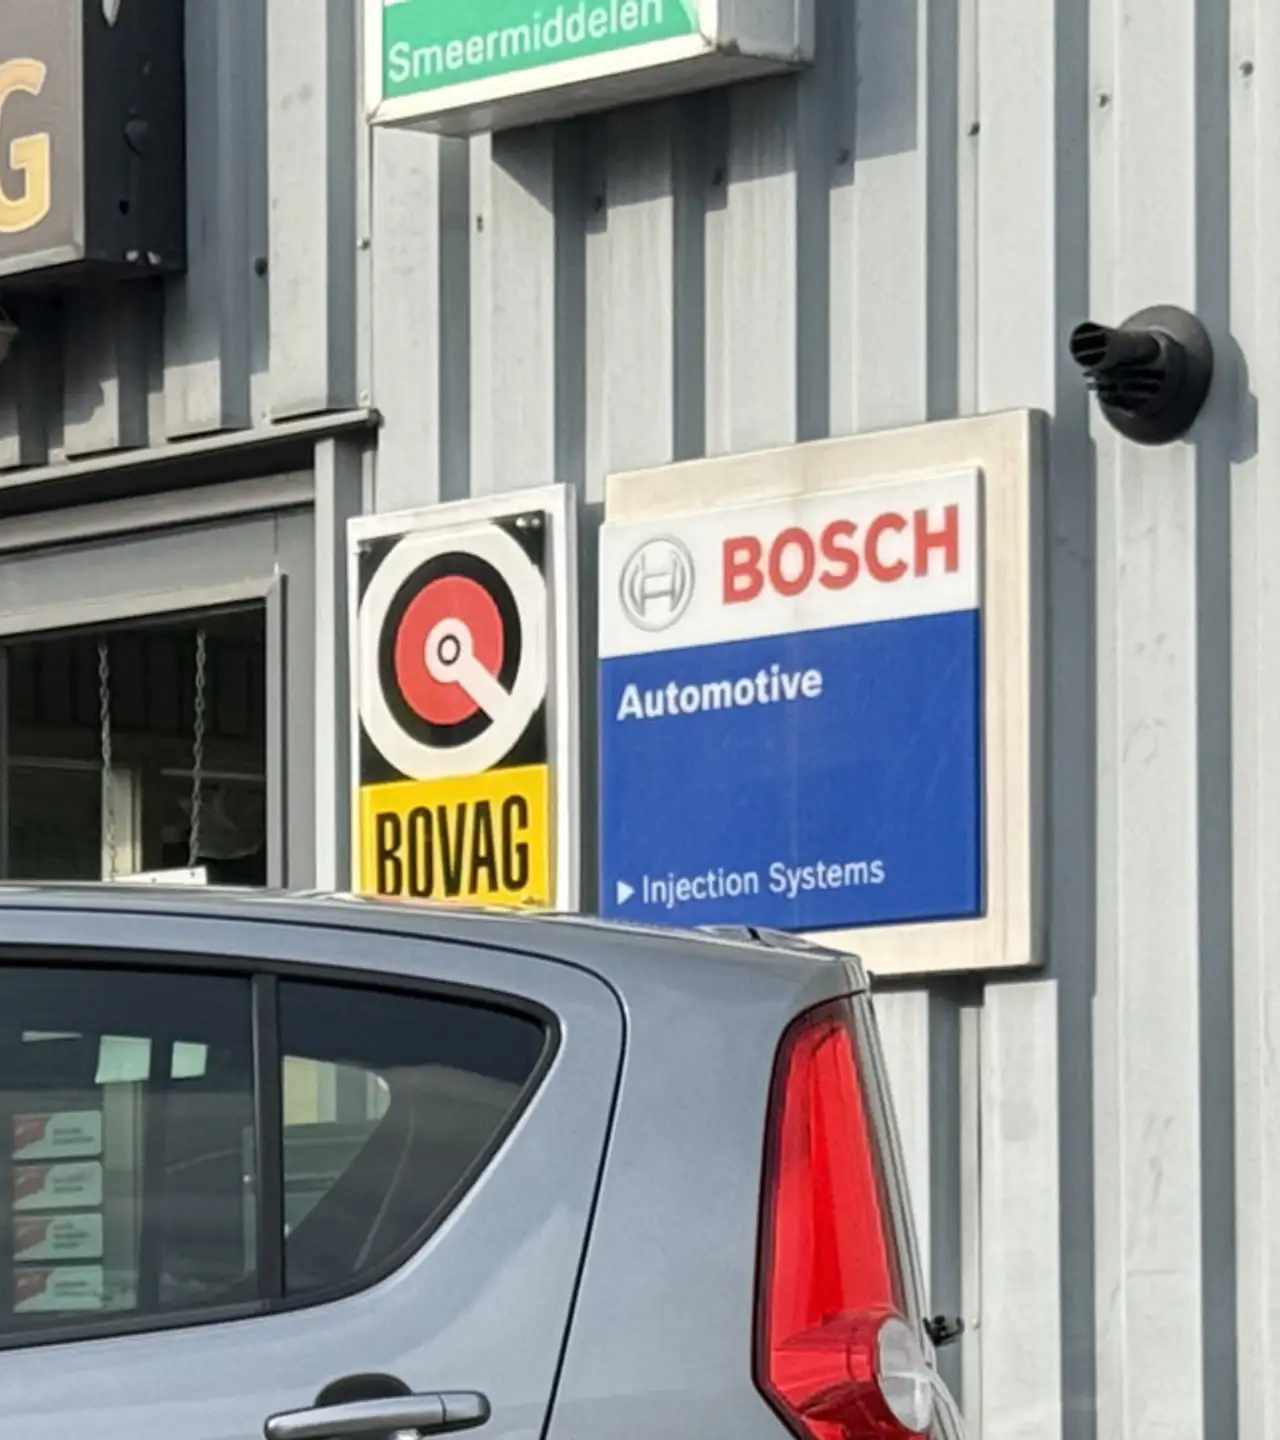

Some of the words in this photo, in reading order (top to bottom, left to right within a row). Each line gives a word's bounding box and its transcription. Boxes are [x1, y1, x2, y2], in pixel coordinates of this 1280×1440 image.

[388, 0, 663, 82] Smeermiddelen
[723, 504, 958, 605] BOSCH
[617, 664, 822, 721] Automotive
[376, 794, 528, 897] BOVAG
[643, 867, 759, 909] Injection
[769, 859, 885, 899] Systems
